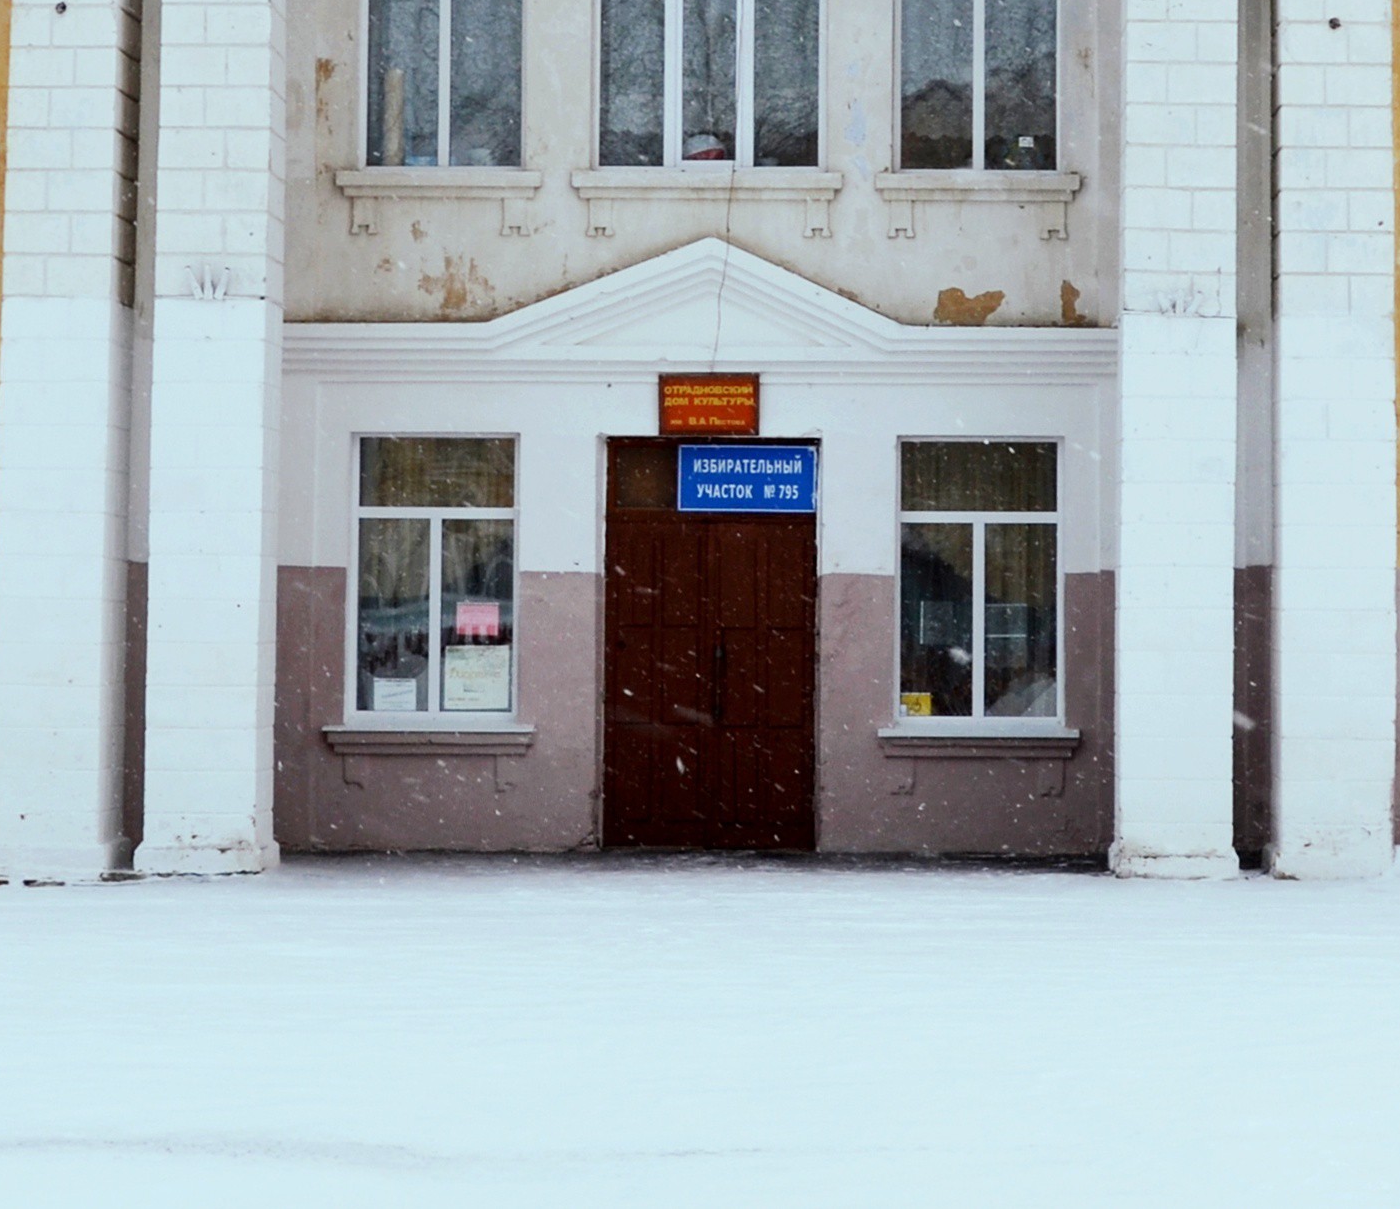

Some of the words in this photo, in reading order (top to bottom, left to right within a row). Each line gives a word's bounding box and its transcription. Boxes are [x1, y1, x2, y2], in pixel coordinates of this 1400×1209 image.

[664, 384, 754, 395] ОТРАДНОВСКИЙ
[664, 397, 689, 407] ДОМ
[694, 397, 754, 406] КУЛЬТУРЫ
[693, 455, 802, 474] ИЗБИРАТЕЛЬНЫЙ
[696, 484, 753, 499] УЧАСТОК
[779, 485, 799, 499] 795
